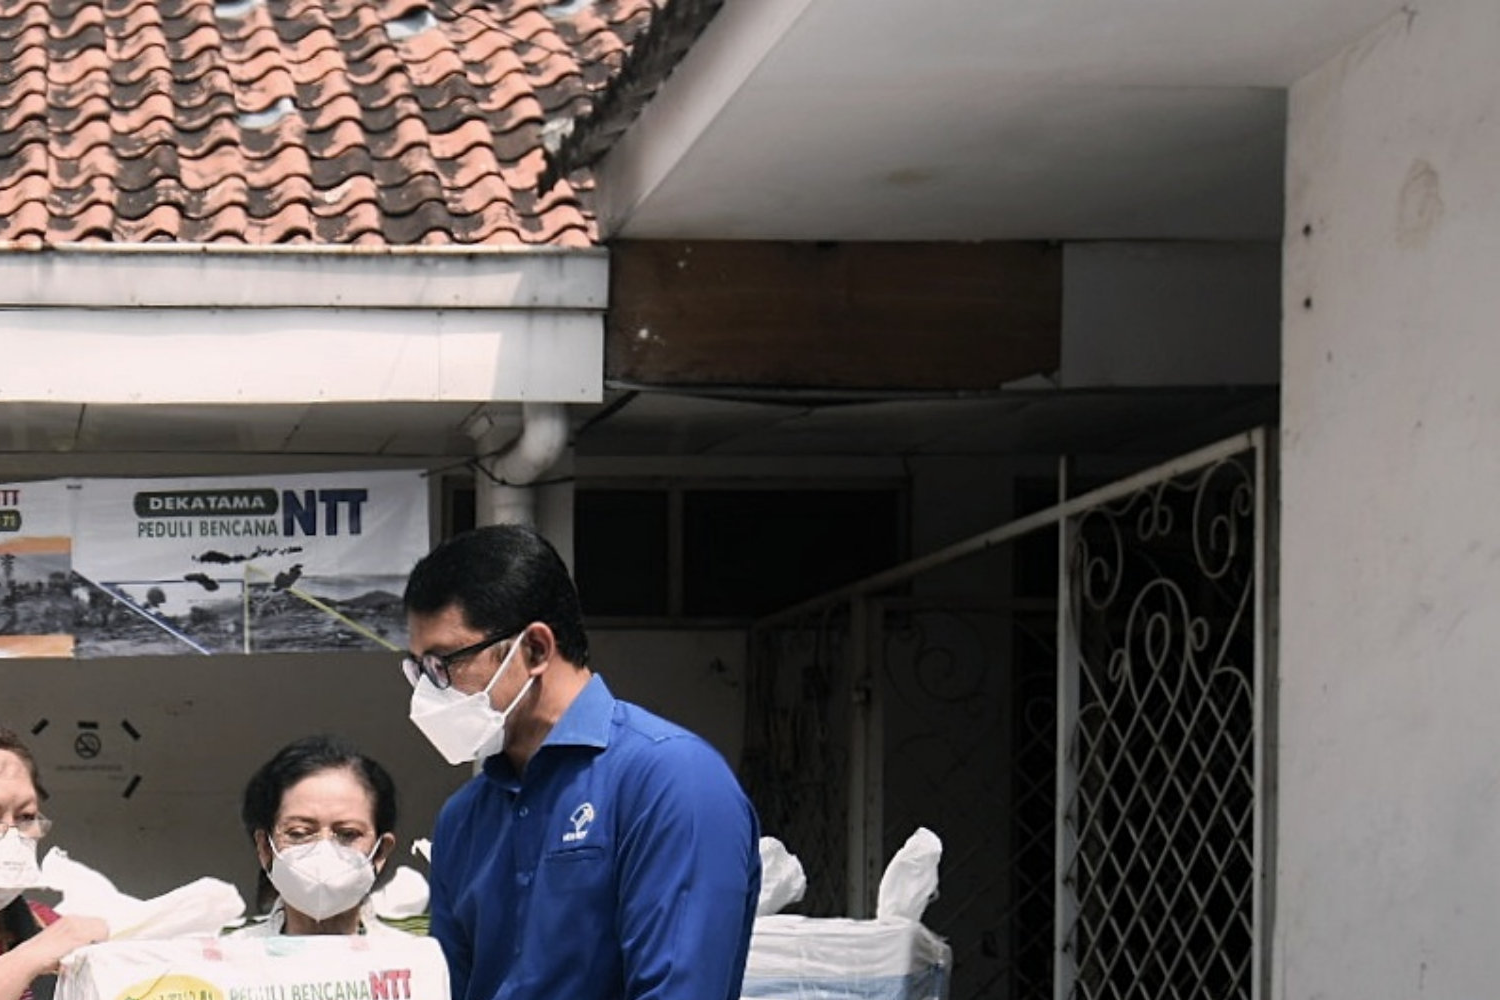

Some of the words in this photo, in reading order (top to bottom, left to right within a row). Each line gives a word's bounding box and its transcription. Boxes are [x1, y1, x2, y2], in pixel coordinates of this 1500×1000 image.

[149, 494, 266, 511] DEKATAMA
[283, 489, 368, 536] NTT
[137, 520, 193, 538] PEDULI
[200, 519, 279, 537] BENCANA
[369, 969, 412, 1000] NTT
